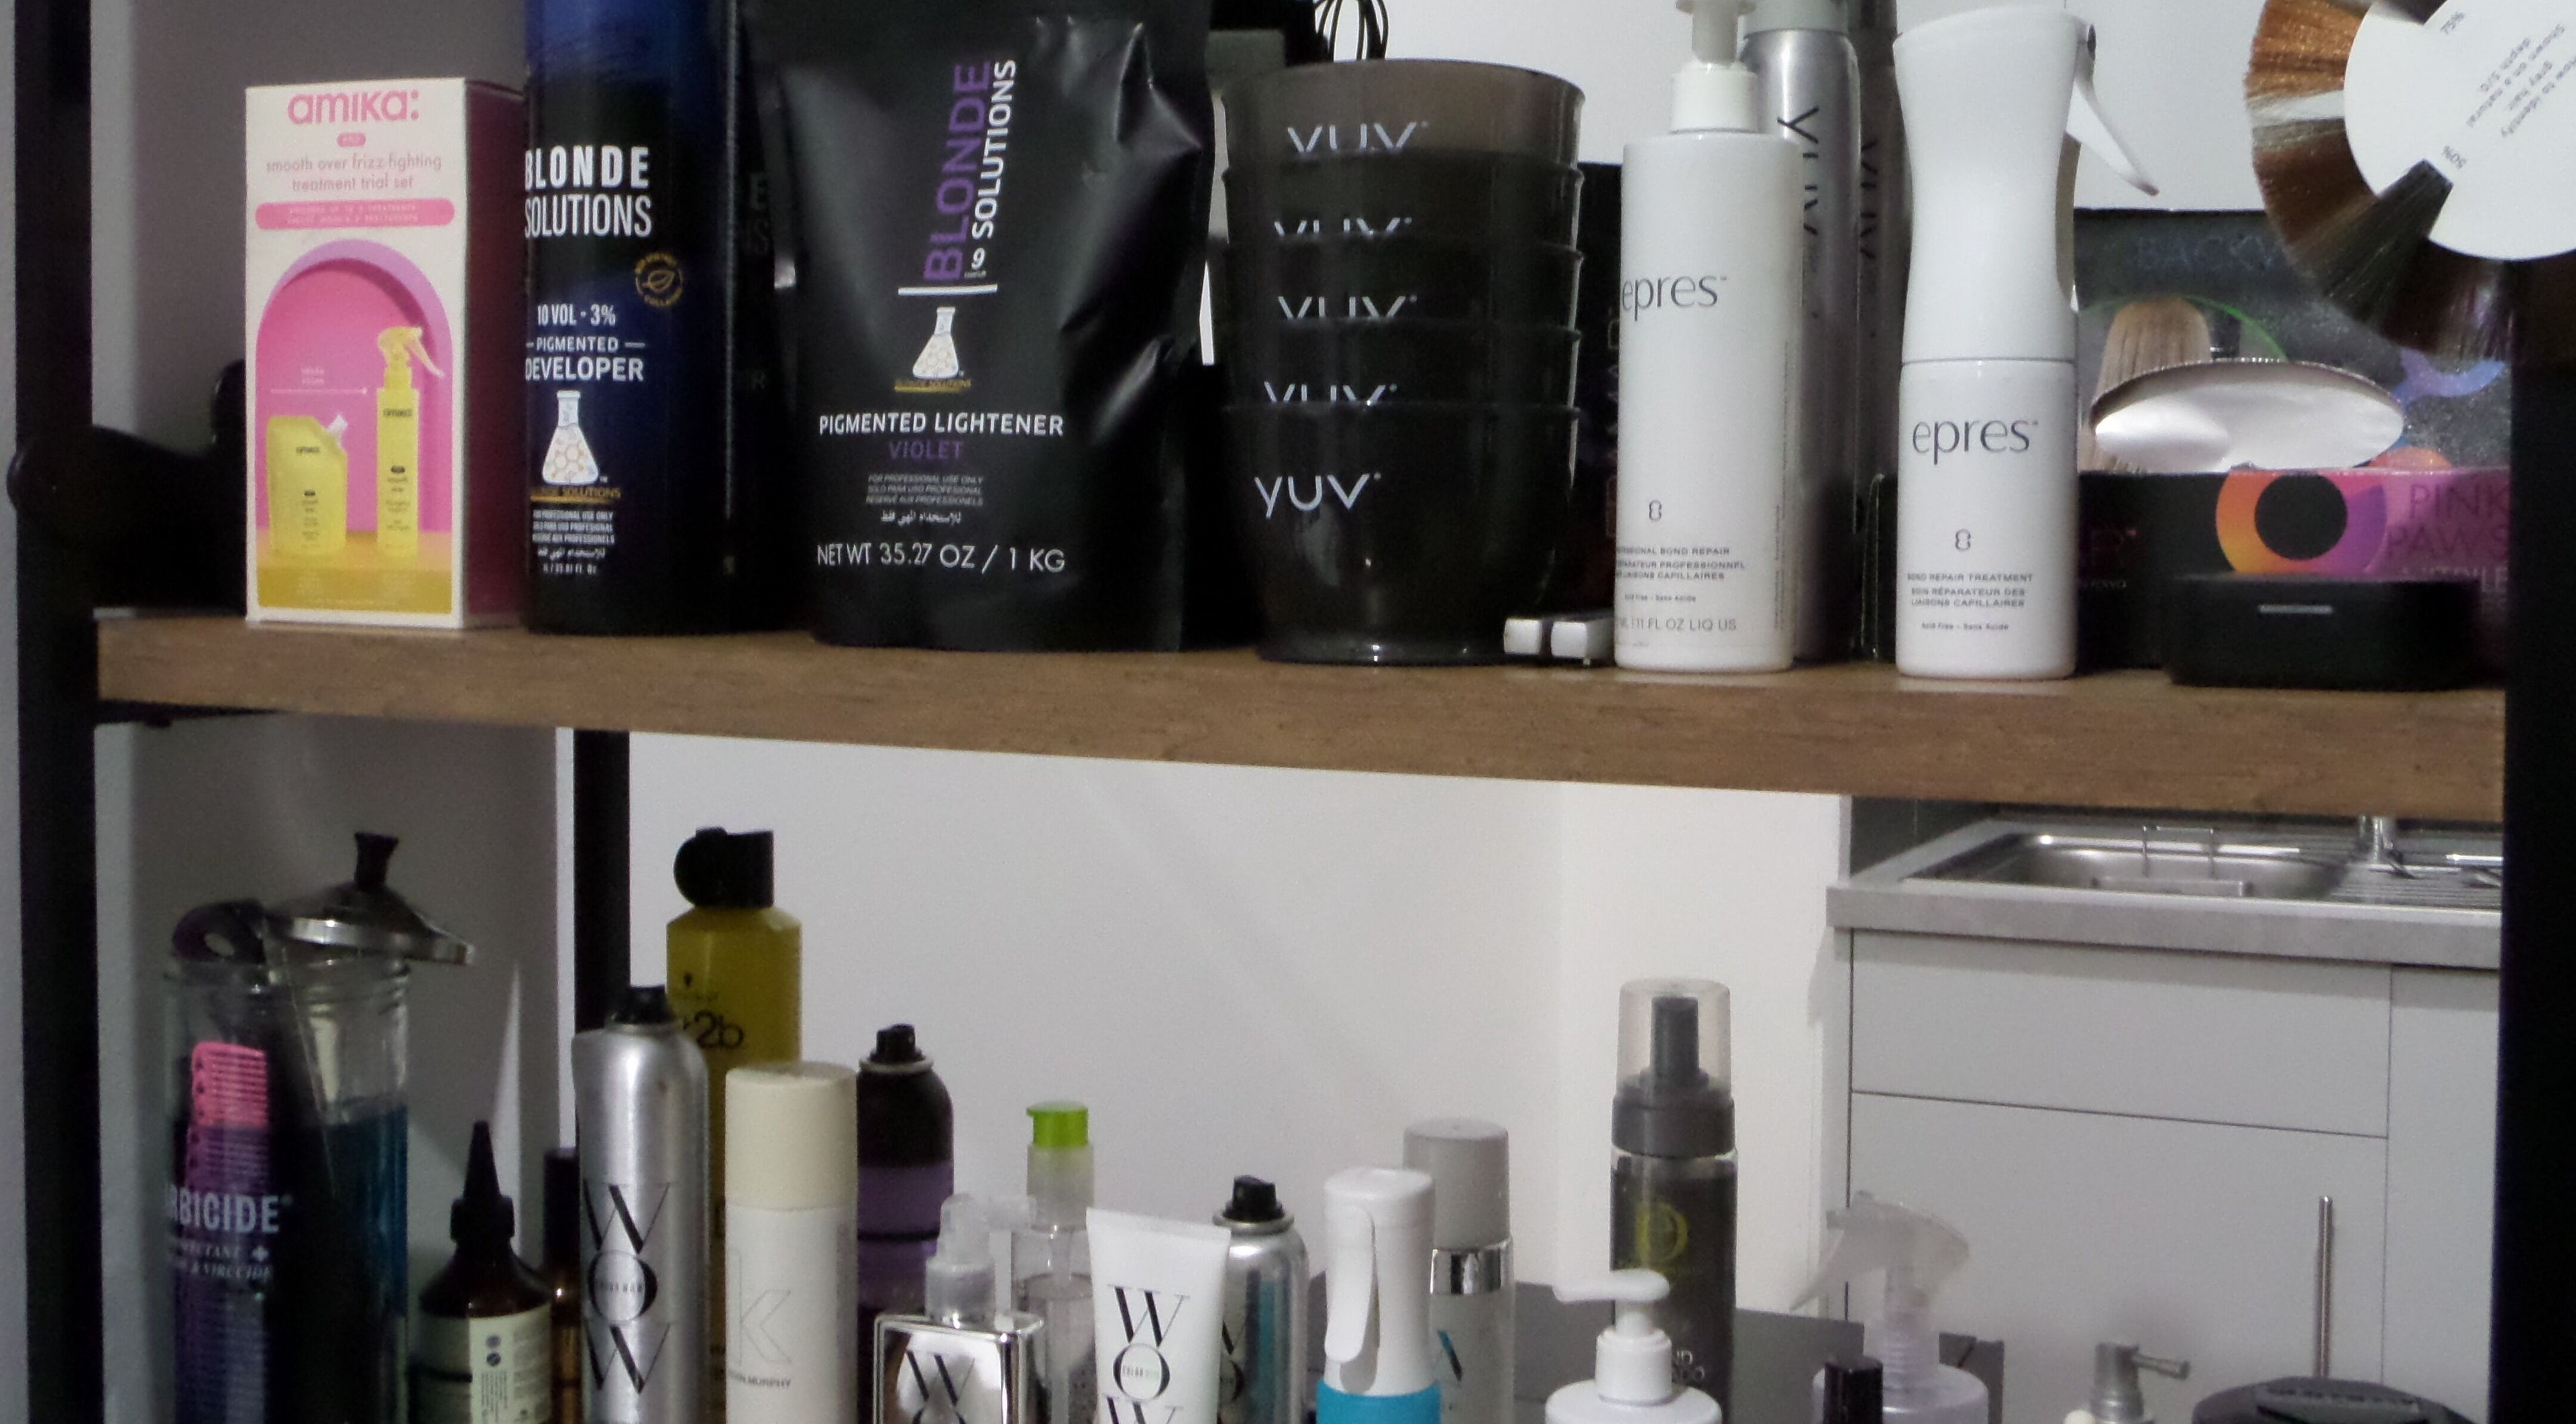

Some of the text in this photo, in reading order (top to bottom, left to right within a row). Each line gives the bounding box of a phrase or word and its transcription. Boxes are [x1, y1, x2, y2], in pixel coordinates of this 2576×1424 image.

[266, 156, 313, 172] smooth
[317, 160, 347, 170] over
[972, 60, 1016, 239] SOLUTIONS
[525, 145, 649, 192] BLONDE
[924, 62, 991, 280] BLONDE
[525, 193, 653, 238] SOLUTIONS
[1621, 275, 1719, 322] epres
[537, 304, 616, 326] 10 VOL 3%
[536, 336, 619, 353] PIGMENTED
[525, 356, 644, 382] DEVELOPER
[819, 412, 1064, 437] PIGMENTED LIGHTENER
[889, 440, 964, 460] VIOLET
[1912, 419, 2031, 466] epres
[817, 543, 843, 566] NET
[847, 542, 873, 565] WT
[879, 542, 933, 567] 35.27
[939, 543, 976, 569] OZ
[1029, 548, 1066, 573] KG
